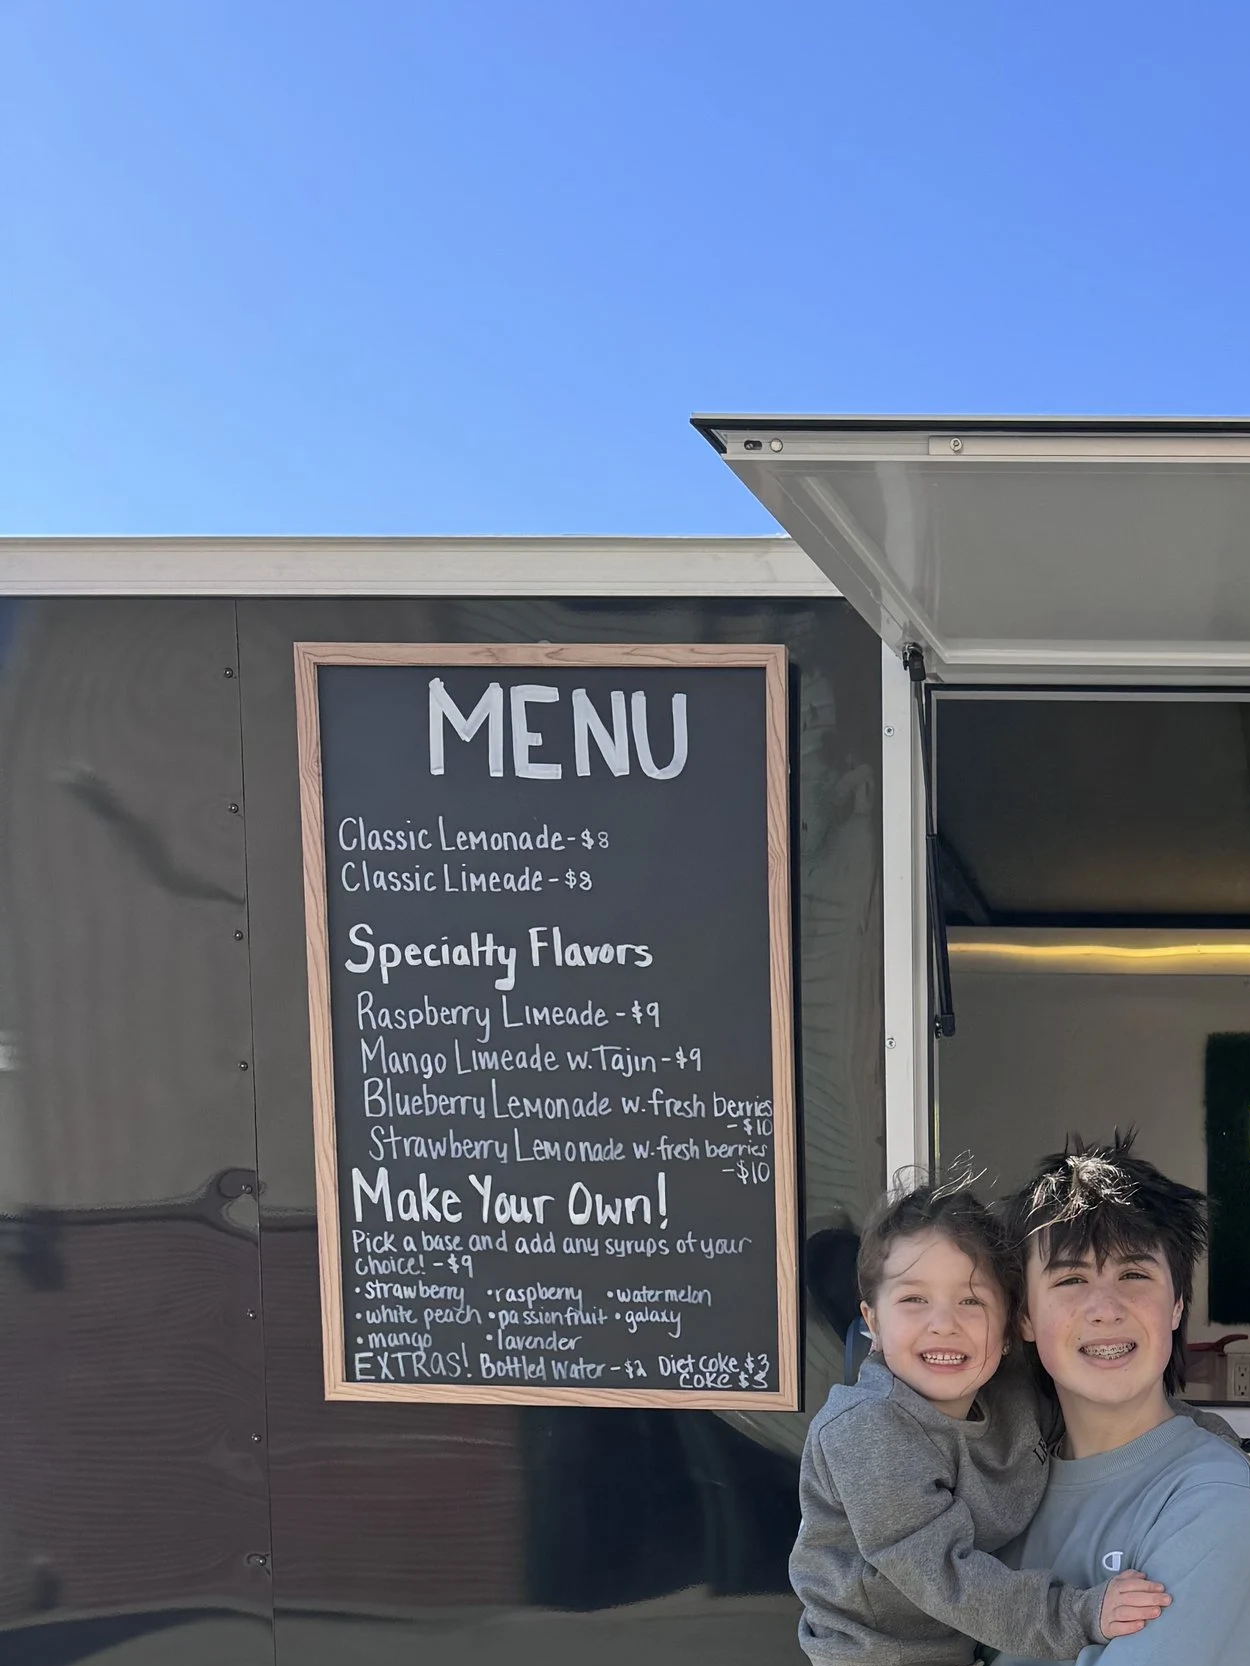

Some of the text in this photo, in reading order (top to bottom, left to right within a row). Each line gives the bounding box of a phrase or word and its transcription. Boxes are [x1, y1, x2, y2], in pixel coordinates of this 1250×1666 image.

[428, 677, 689, 780] MENU
[338, 816, 433, 851] Classic
[341, 860, 437, 892] Classic
[444, 862, 543, 892] Limeade
[344, 922, 654, 991] Specialty Flavors
[356, 990, 491, 1044] Raspberry
[501, 994, 609, 1028] Limeade
[360, 1035, 447, 1079] Mango
[454, 1038, 560, 1075] Limeade
[363, 1077, 485, 1119] Blueberry
[491, 1078, 613, 1120] Lemonade
[647, 1087, 706, 1118] fresh
[713, 1091, 773, 1118] berries
[368, 1125, 508, 1164] Strawberry
[513, 1127, 626, 1162] Lemonade
[656, 1135, 700, 1161] fresh
[704, 1139, 768, 1158] berries
[351, 1166, 669, 1230] Make Your Own!
[351, 1229, 398, 1254] Pick
[402, 1235, 418, 1252] a
[421, 1230, 464, 1252] base
[468, 1229, 508, 1253] and
[514, 1231, 556, 1254] add
[562, 1236, 600, 1257] any
[604, 1237, 670, 1258] syrups
[700, 1236, 753, 1259] your
[366, 1304, 418, 1325] white
[423, 1304, 482, 1330] peach
[624, 1307, 682, 1339] galaxy
[367, 1328, 583, 1352] mango lavender
[353, 1341, 473, 1381] EXTRAS!
[479, 1353, 547, 1381] Bottled
[551, 1357, 607, 1380] Water
[658, 1354, 696, 1377] Diet
